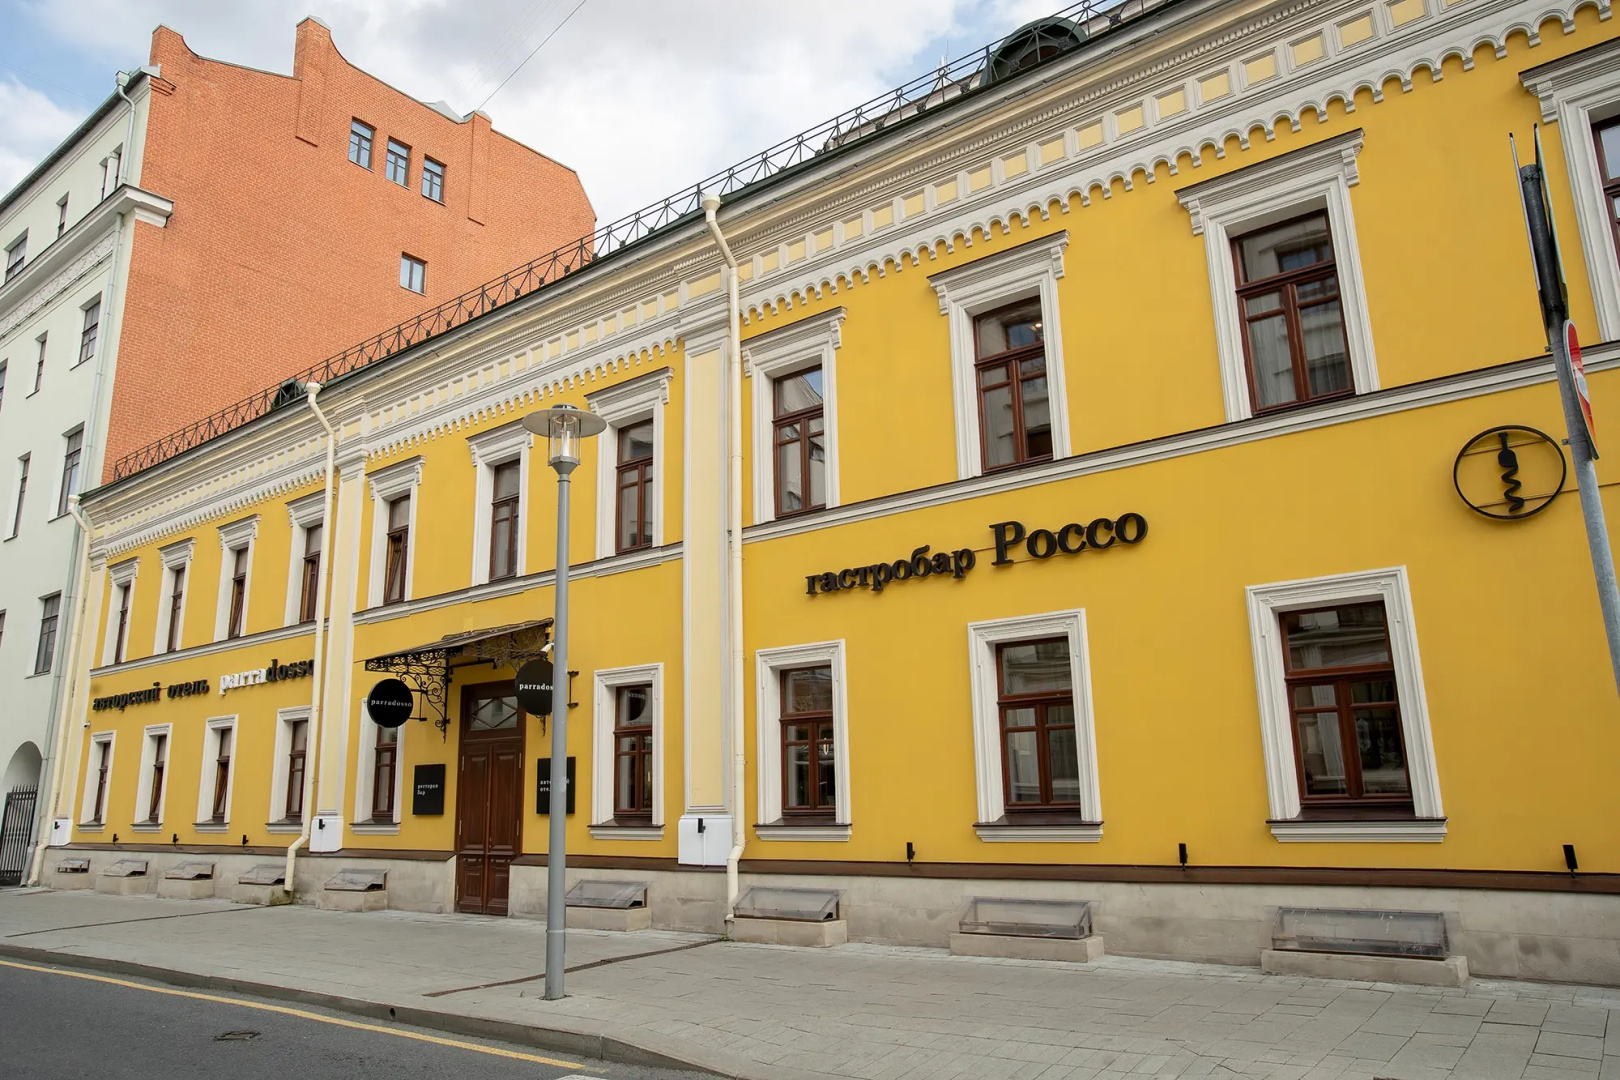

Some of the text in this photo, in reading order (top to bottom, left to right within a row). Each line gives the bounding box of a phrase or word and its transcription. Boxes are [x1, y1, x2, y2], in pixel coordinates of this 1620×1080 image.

[805, 512, 1149, 595] гастробар Россо
[92, 681, 161, 712] авторский
[167, 678, 210, 699] отель
[370, 699, 413, 708] parradosso
